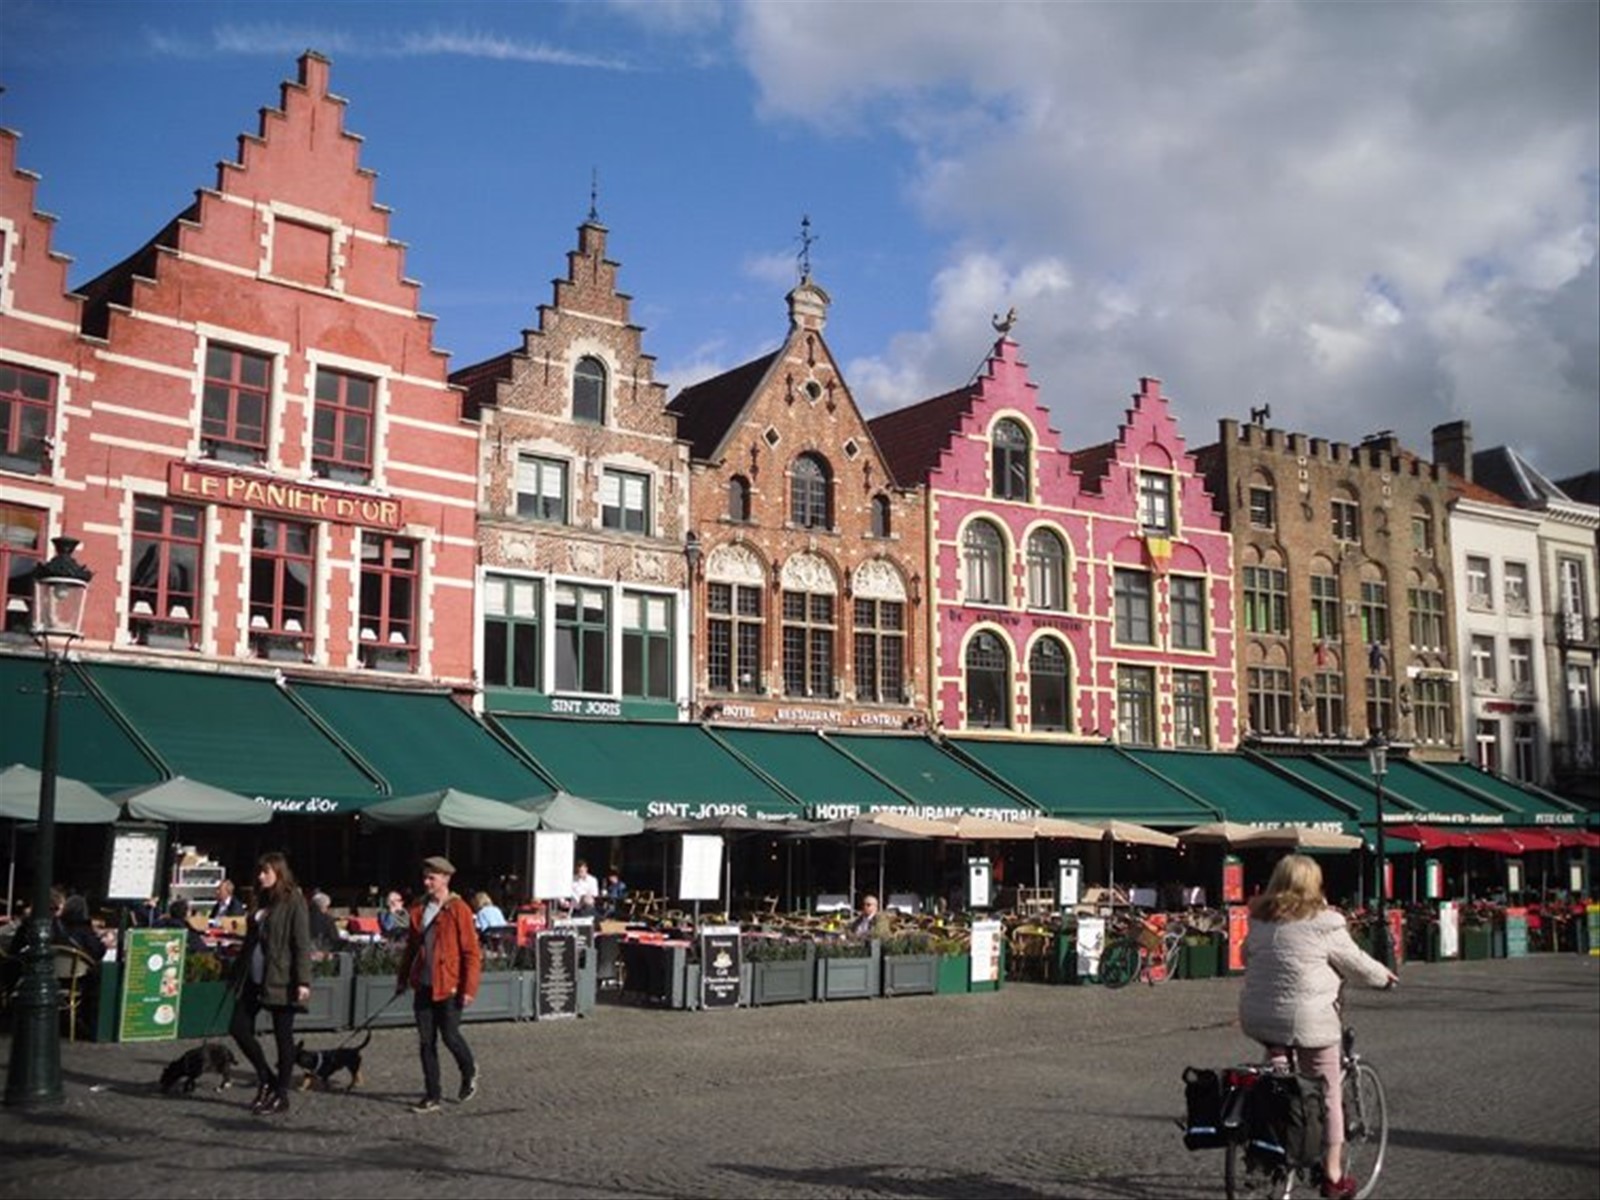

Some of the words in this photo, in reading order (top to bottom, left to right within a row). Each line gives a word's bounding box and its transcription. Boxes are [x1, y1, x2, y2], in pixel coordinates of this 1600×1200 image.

[182, 472, 220, 497] LE
[226, 476, 329, 514] PANIER
[337, 498, 397, 525] D'OR
[551, 698, 582, 714] SINT
[585, 701, 621, 716] JORIS
[722, 704, 755, 718] HOTEL
[778, 708, 842, 722] RESTAURANT
[305, 797, 339, 812] d'Or
[646, 800, 749, 820] SINT-JORIS
[816, 803, 860, 820] HOTEL
[869, 804, 964, 821] RESTAURANT
